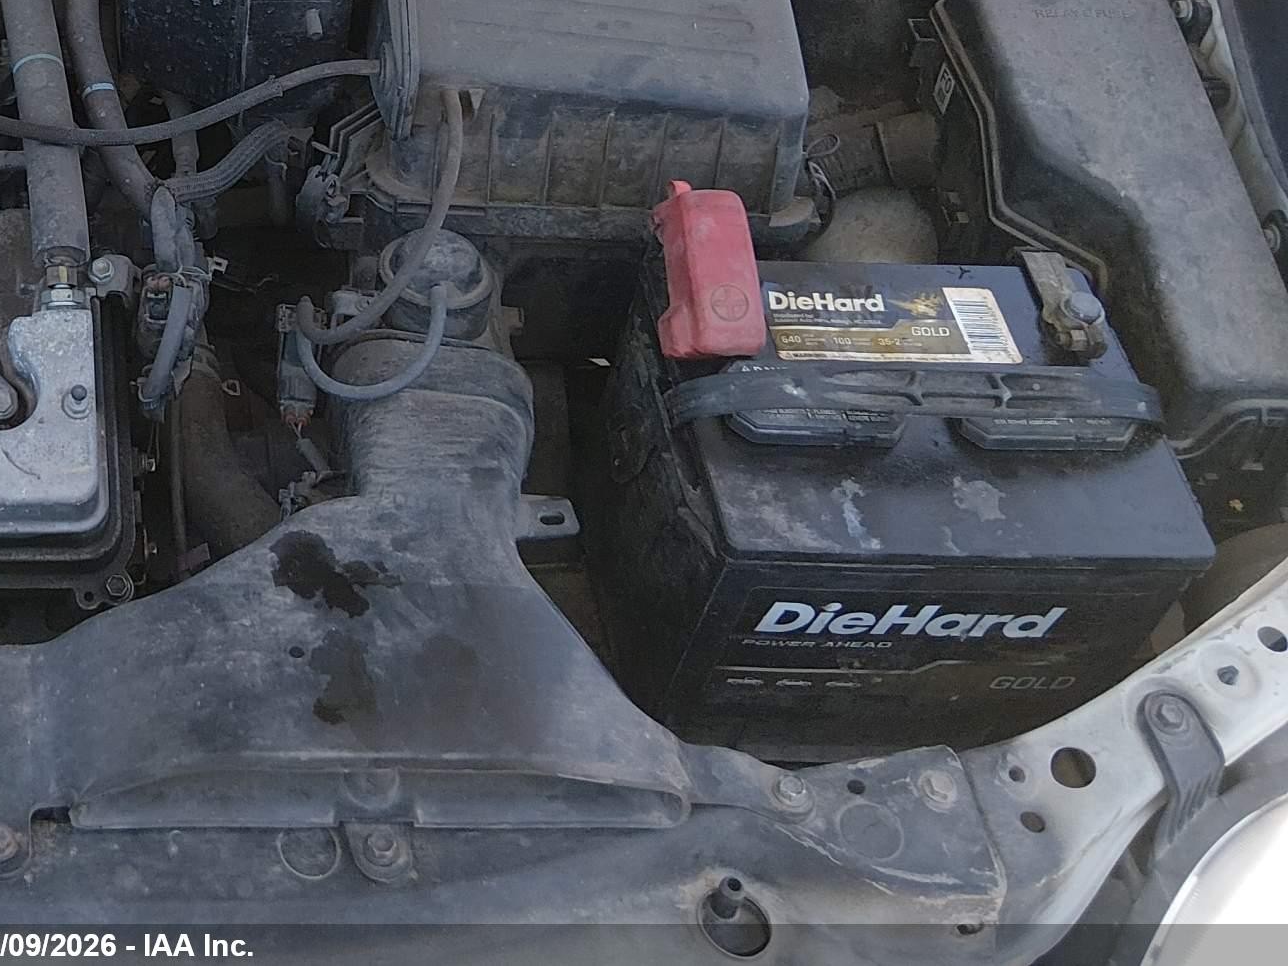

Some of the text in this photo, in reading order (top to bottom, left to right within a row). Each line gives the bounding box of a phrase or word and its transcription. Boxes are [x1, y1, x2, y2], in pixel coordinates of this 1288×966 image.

[768, 291, 885, 312] DieHard
[911, 325, 950, 337] GOLD
[754, 601, 1068, 639] DieHard
[742, 638, 893, 649] POWER AHEAD
[989, 675, 1077, 690] GOLD
